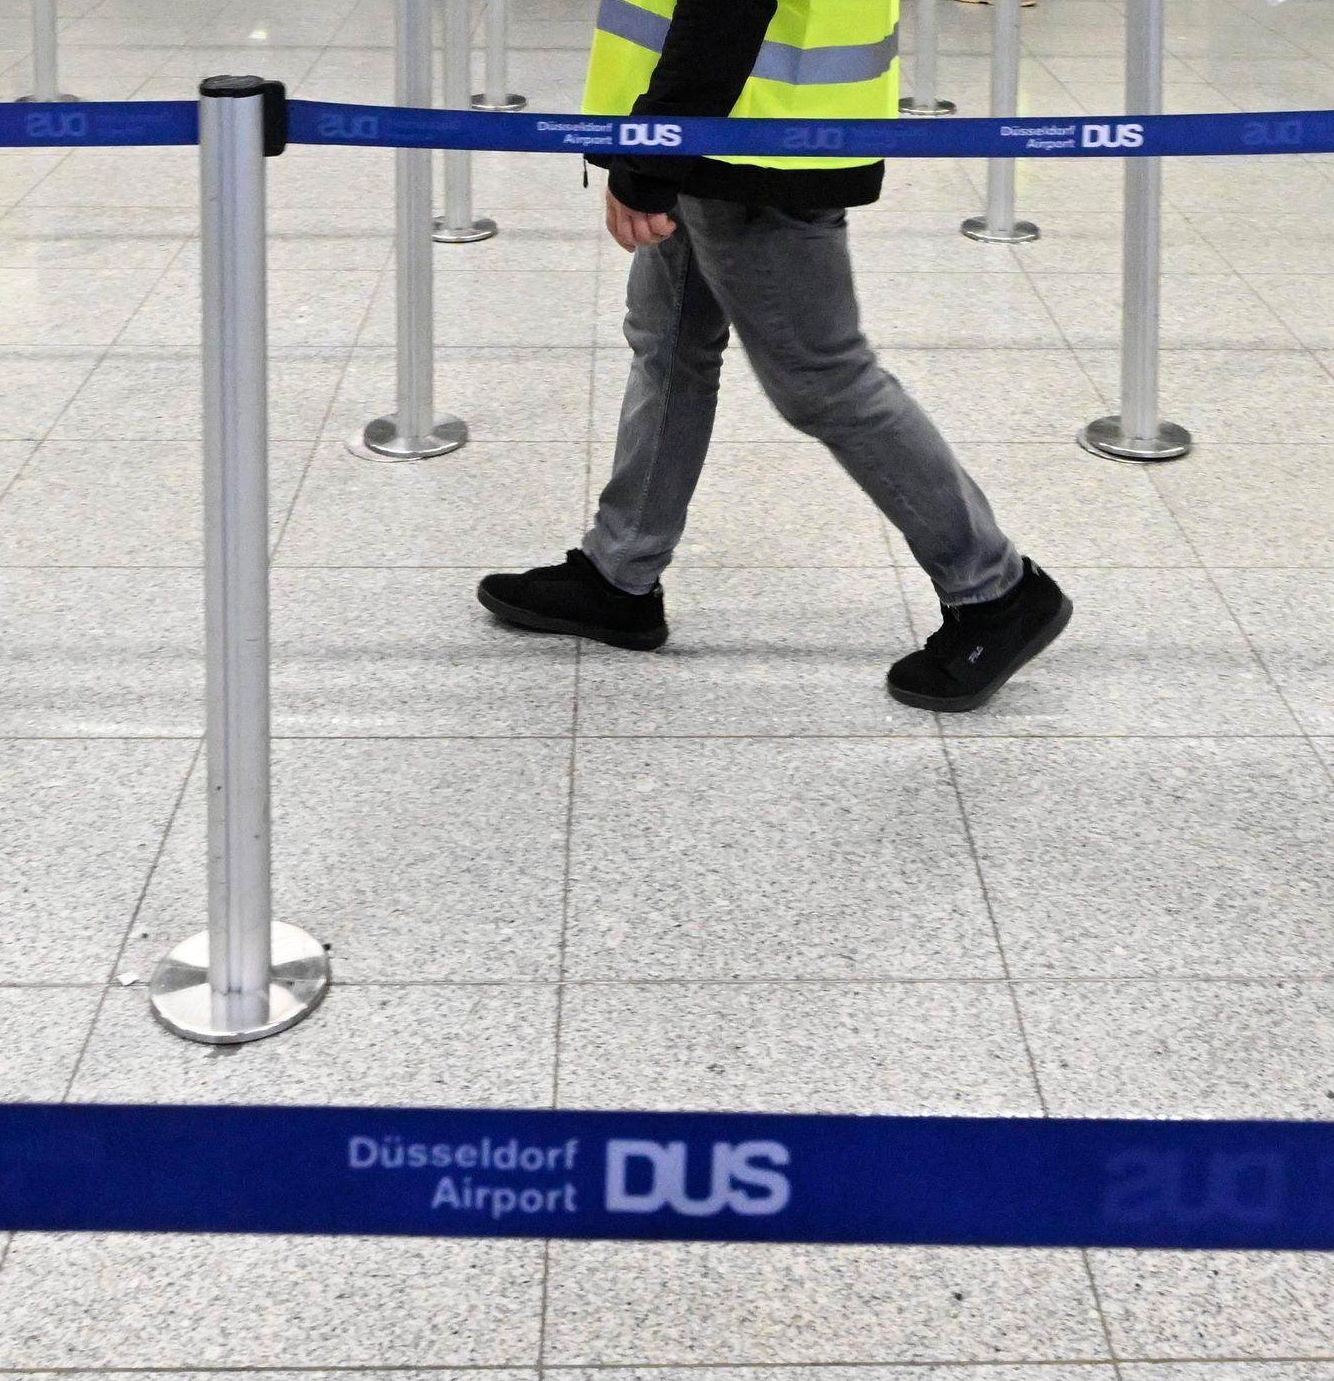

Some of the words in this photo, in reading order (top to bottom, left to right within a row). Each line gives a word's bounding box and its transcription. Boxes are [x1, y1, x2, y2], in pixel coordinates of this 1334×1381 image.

[536, 121, 613, 134] Düsseldorf
[619, 124, 682, 148] DUS
[1000, 124, 1075, 137] Düsseldorf
[1082, 124, 1145, 148] DUS
[563, 133, 613, 148] Airport
[1026, 138, 1075, 152] Airport
[349, 1136, 578, 1171] Düsseldorf
[605, 1139, 791, 1216] DUS
[431, 1176, 578, 1220] Airport
